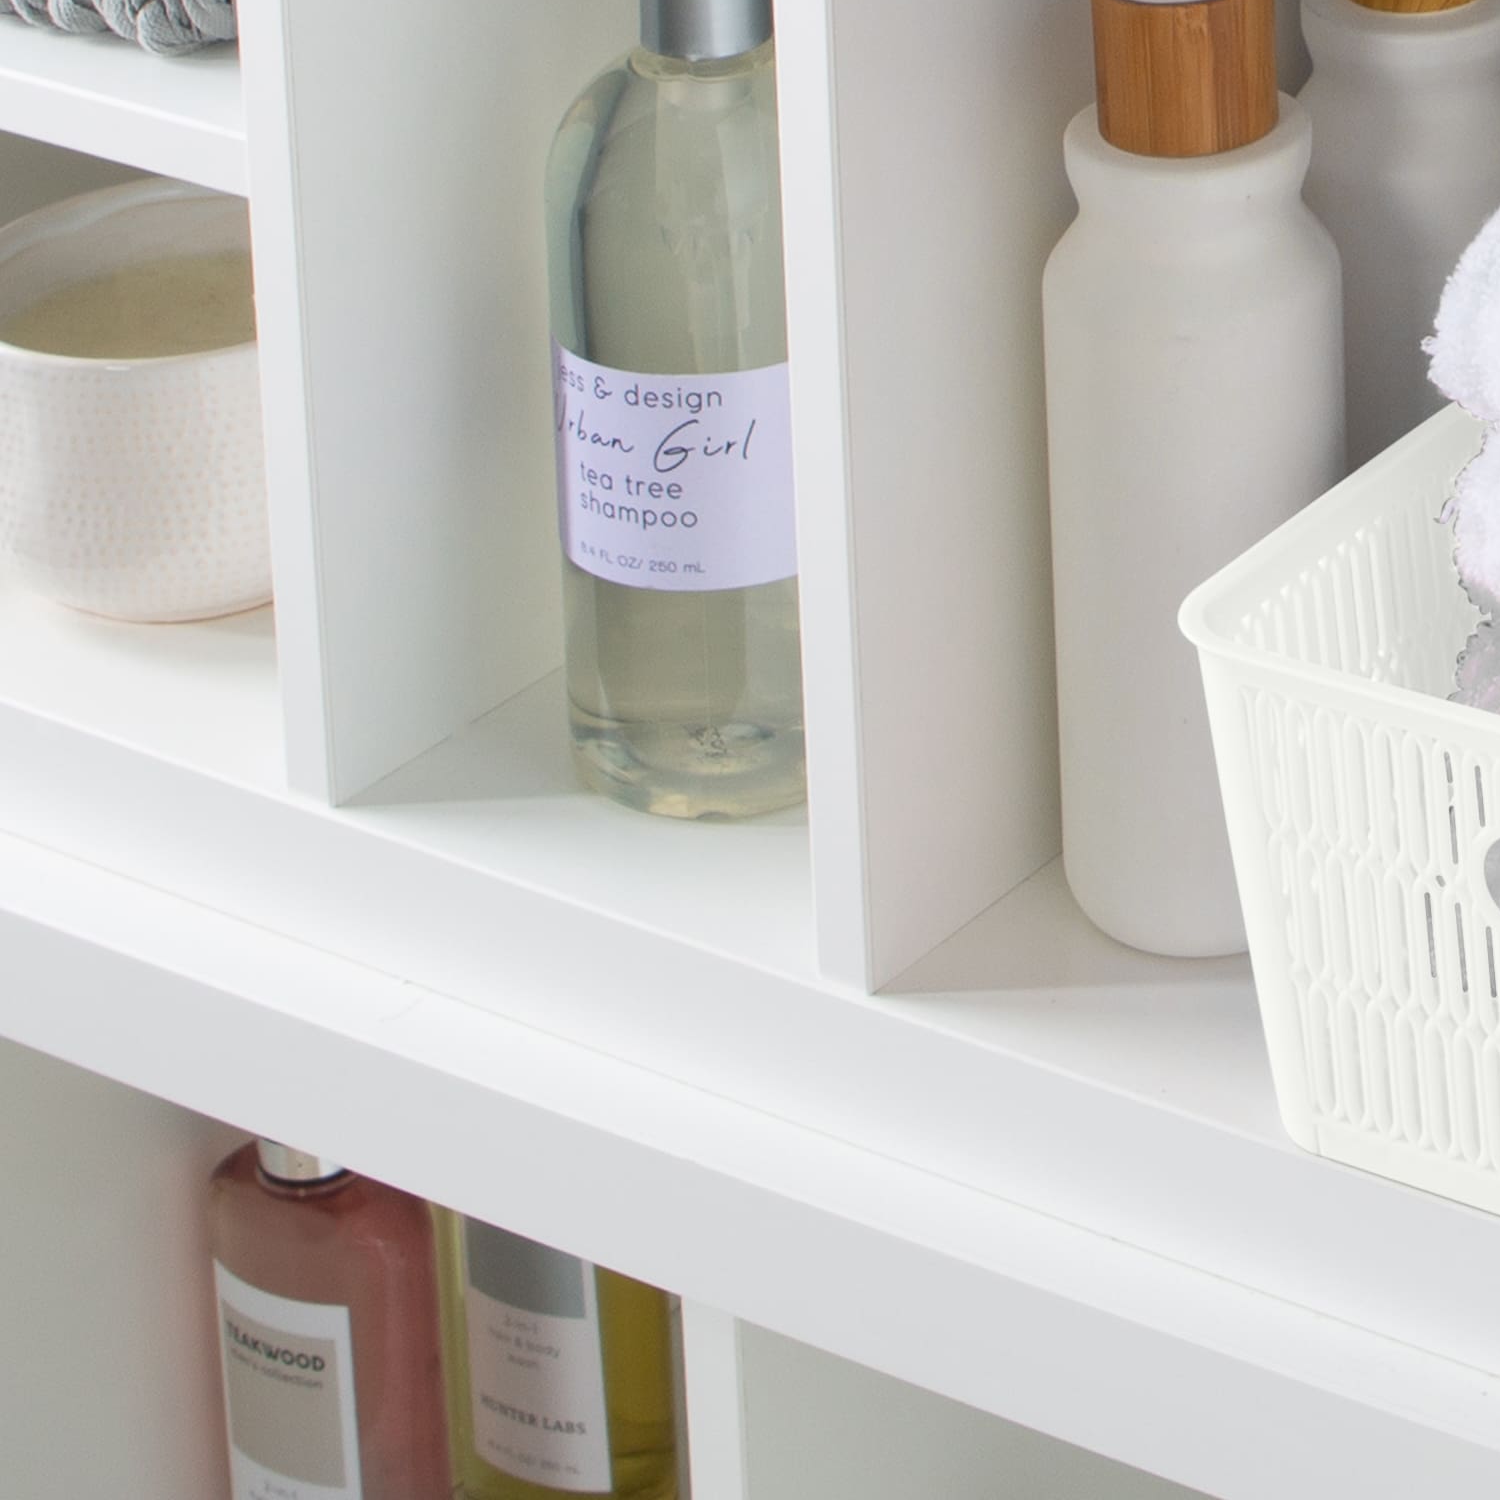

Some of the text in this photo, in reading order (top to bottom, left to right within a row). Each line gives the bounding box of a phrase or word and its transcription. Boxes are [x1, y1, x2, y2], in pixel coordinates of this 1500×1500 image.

[594, 375, 613, 400] &
[623, 383, 723, 414] design
[653, 418, 756, 473] Girl
[579, 461, 684, 500] tea tree
[579, 490, 698, 531] shampoo
[648, 559, 678, 574] 250
[683, 560, 706, 575] mL
[225, 1319, 325, 1372] TEAKWOOD
[541, 1415, 587, 1437] LABS
